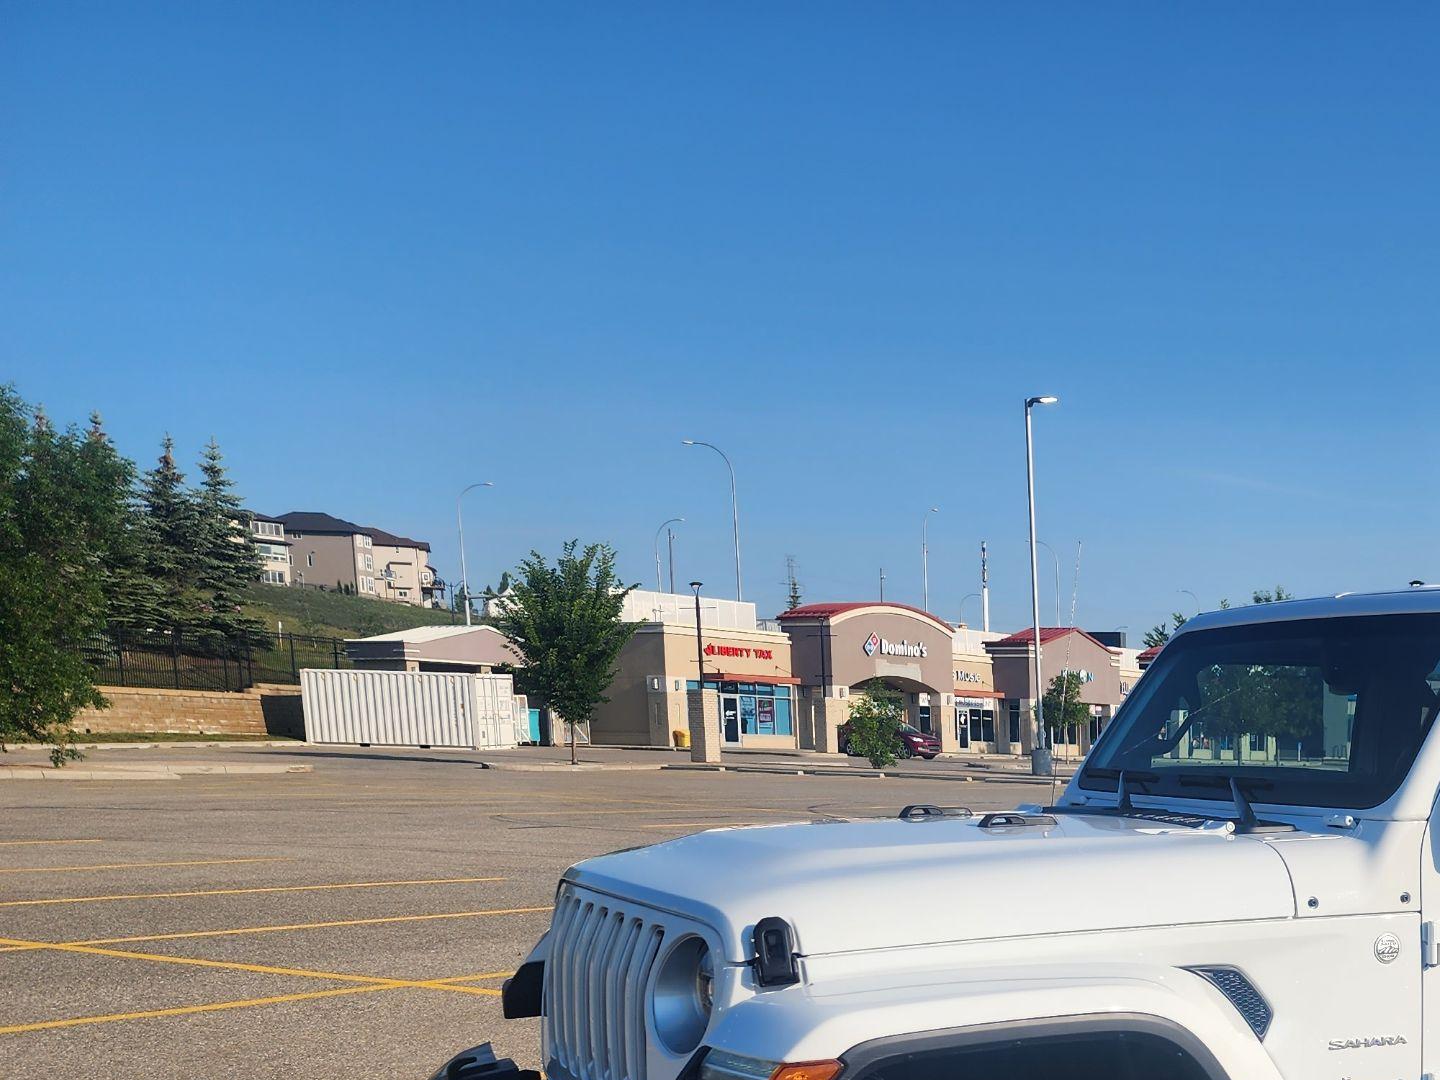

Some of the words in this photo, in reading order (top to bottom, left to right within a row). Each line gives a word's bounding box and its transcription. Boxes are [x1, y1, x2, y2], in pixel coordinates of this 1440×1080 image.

[711, 645, 752, 659] LIBERTY
[752, 648, 773, 660] TAX
[880, 638, 928, 658] Domino's
[1328, 1035, 1408, 1051] SAHARA
